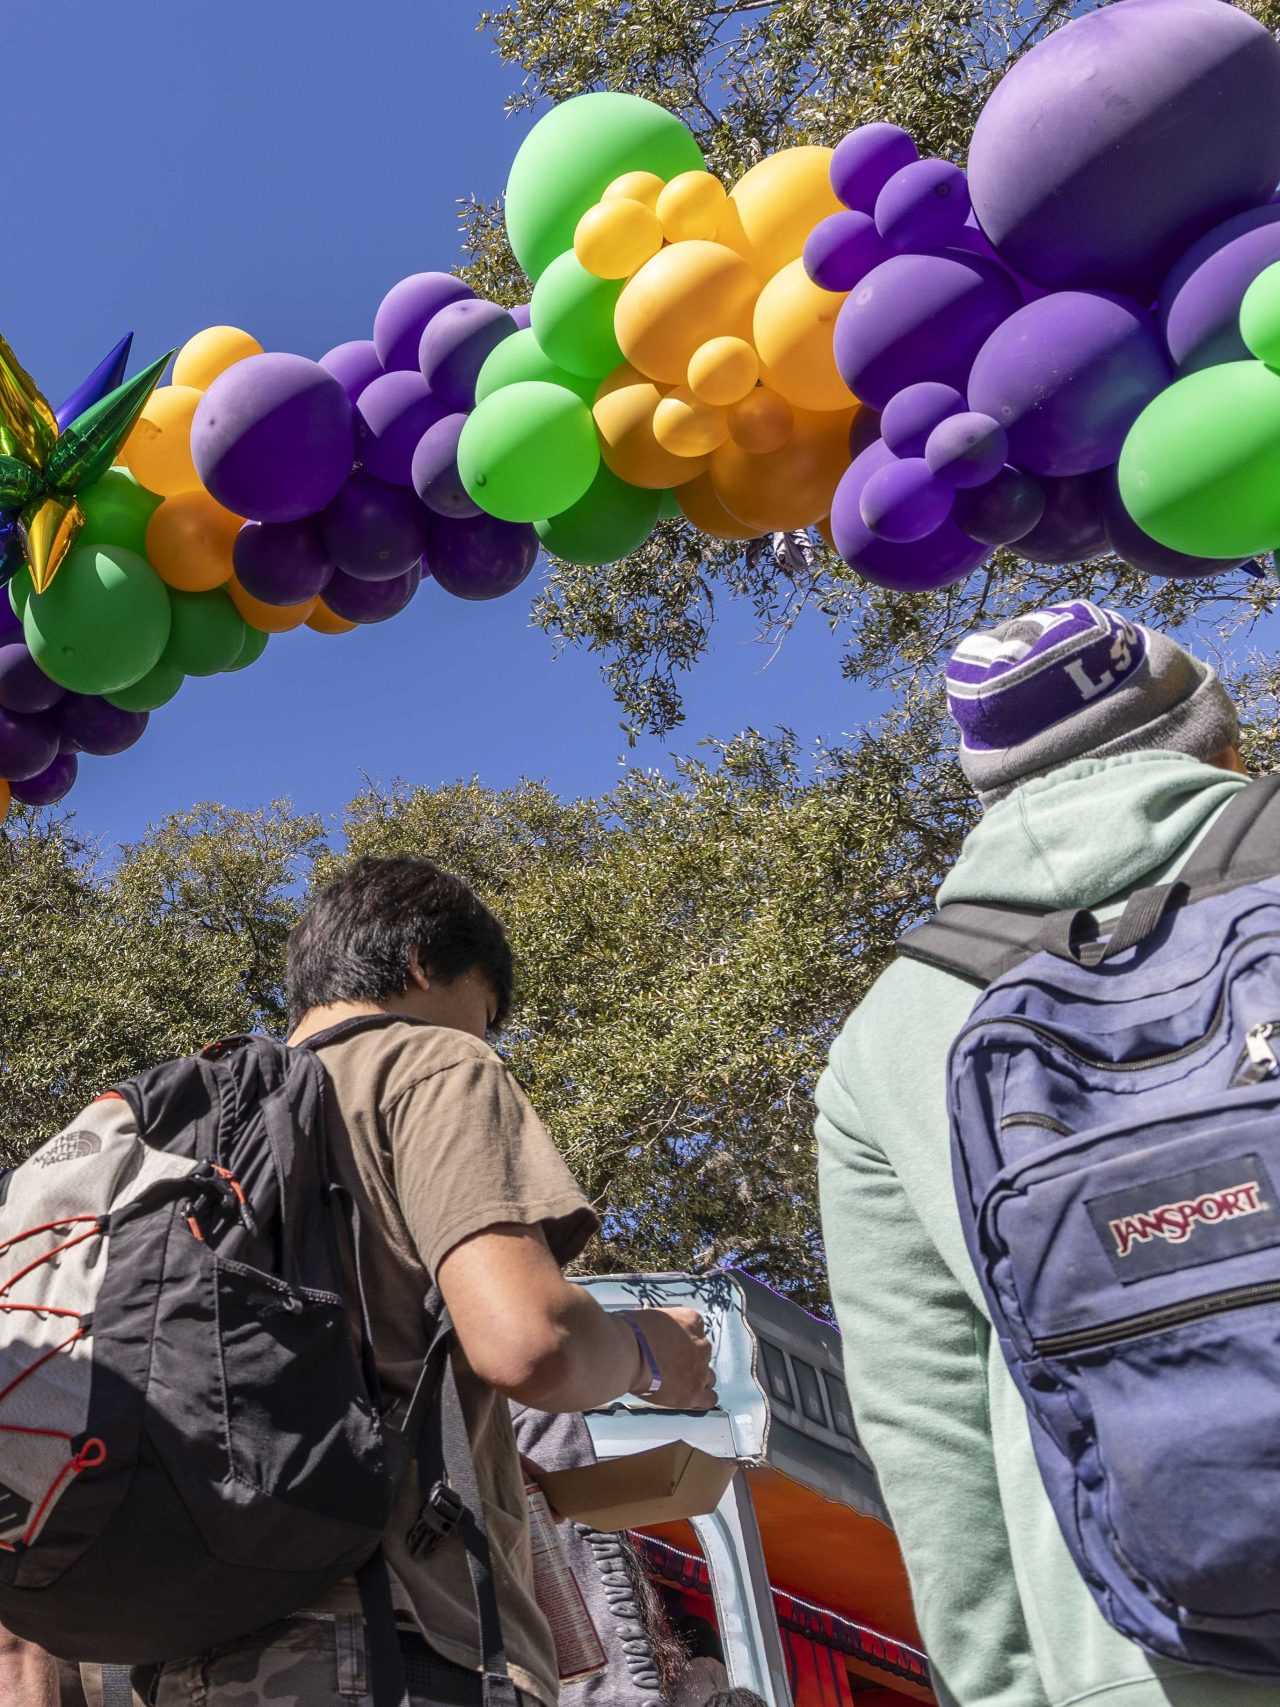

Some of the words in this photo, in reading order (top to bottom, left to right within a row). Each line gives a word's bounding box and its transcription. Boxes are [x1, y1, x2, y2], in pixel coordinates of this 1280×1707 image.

[54, 1131, 79, 1147] THE
[33, 1141, 77, 1165] NORTH
[41, 1152, 73, 1168] FACE
[1109, 1181, 1261, 1257] JANSPORT
